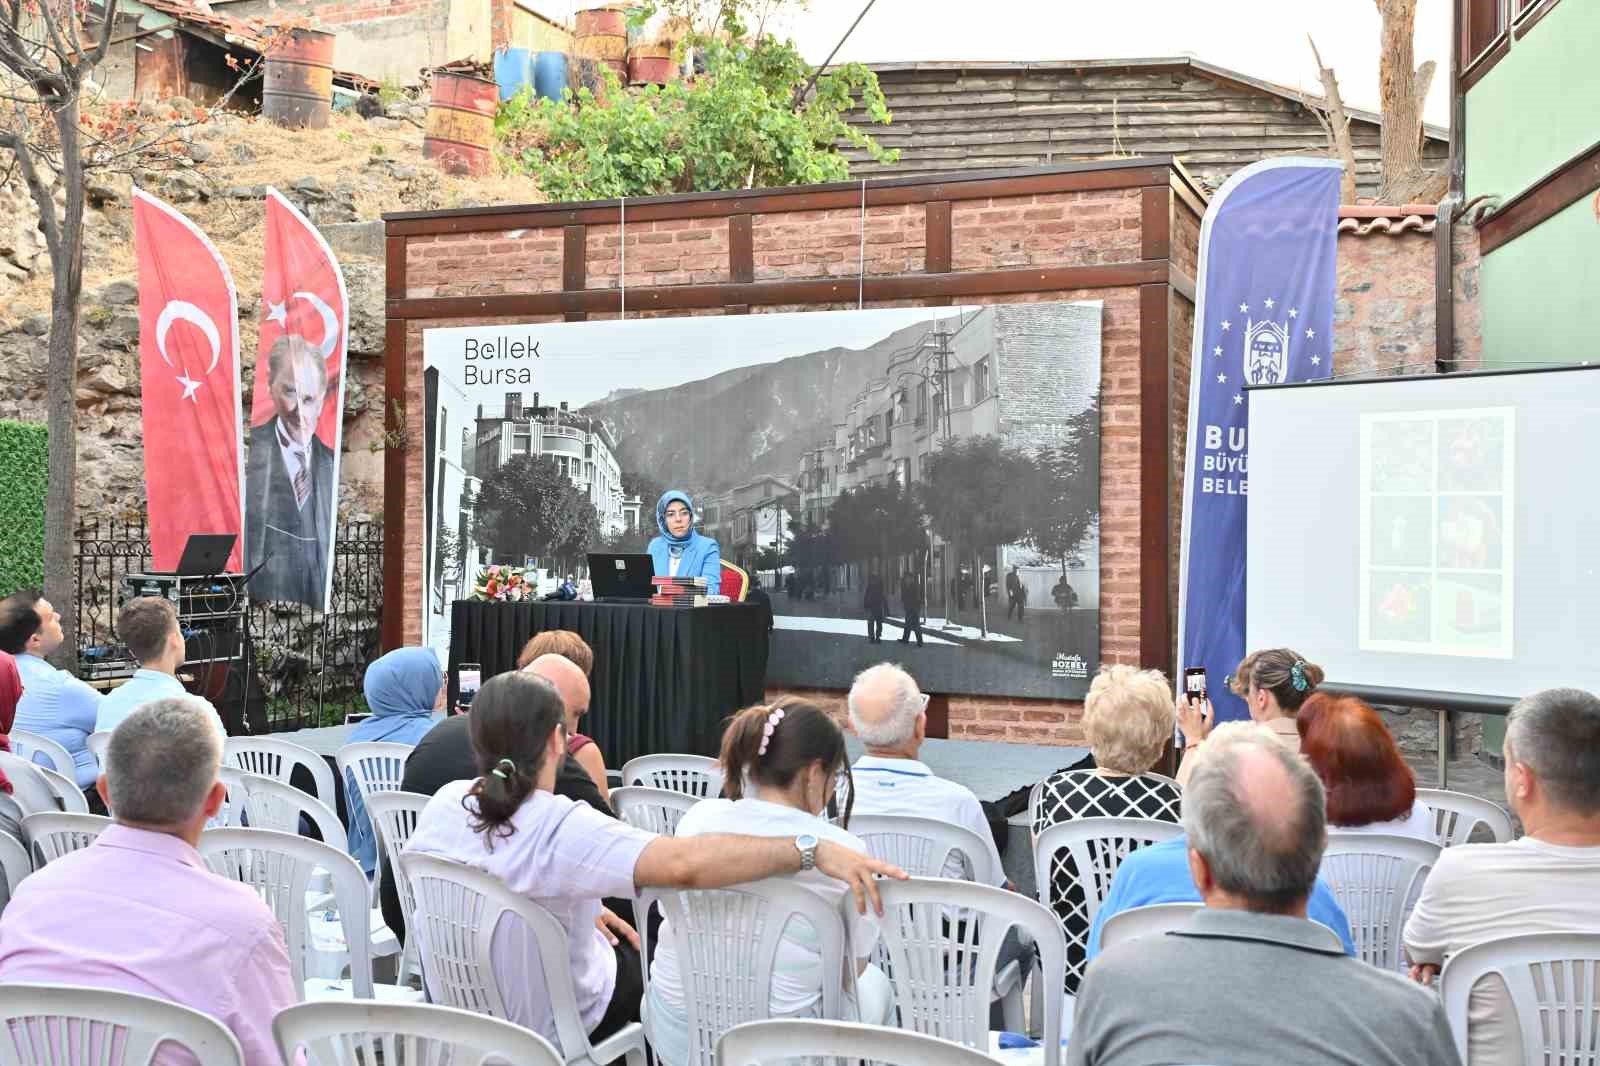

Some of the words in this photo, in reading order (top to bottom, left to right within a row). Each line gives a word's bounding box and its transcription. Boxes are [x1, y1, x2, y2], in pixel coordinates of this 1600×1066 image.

[465, 336, 540, 360] Bellek
[465, 365, 531, 385] Bursa
[1205, 425, 1246, 451] BU
[1203, 452, 1248, 473] BÜYÜ
[1052, 660, 1087, 669] BOZBEY
